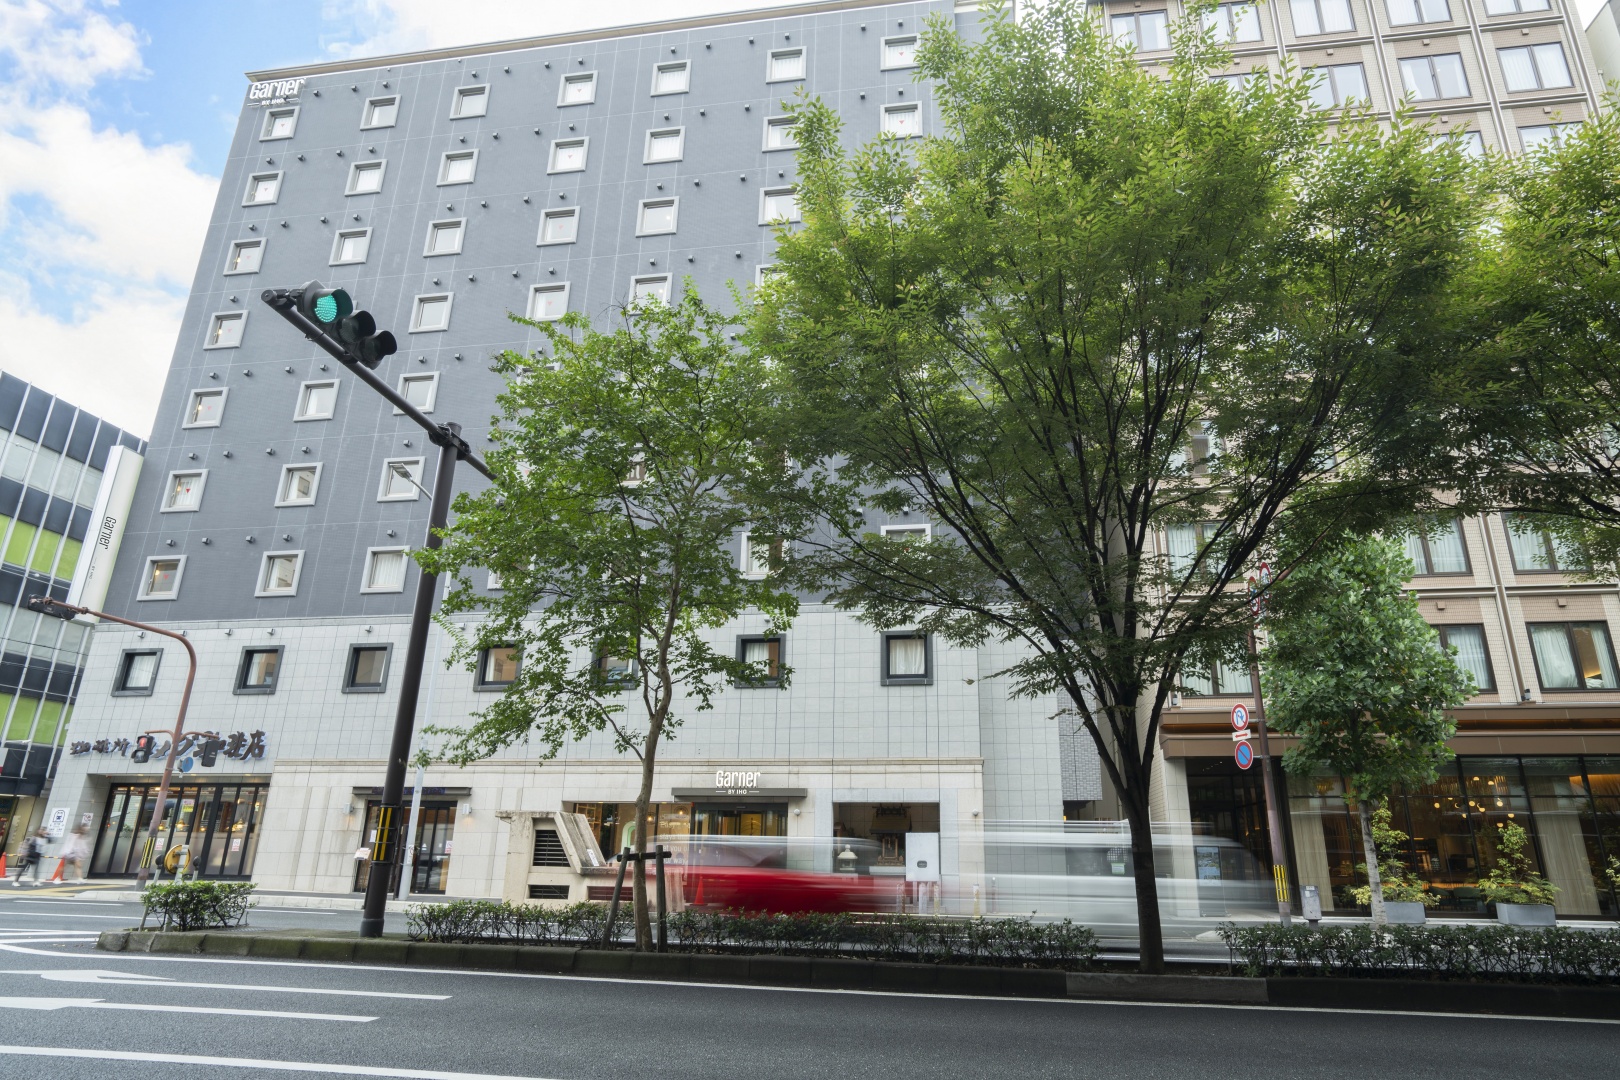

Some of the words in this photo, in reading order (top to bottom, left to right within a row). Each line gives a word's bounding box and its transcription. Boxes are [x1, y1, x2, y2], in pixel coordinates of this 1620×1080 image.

[250, 79, 305, 99] Garner
[99, 516, 117, 550] Garner
[715, 770, 761, 787] Garner
